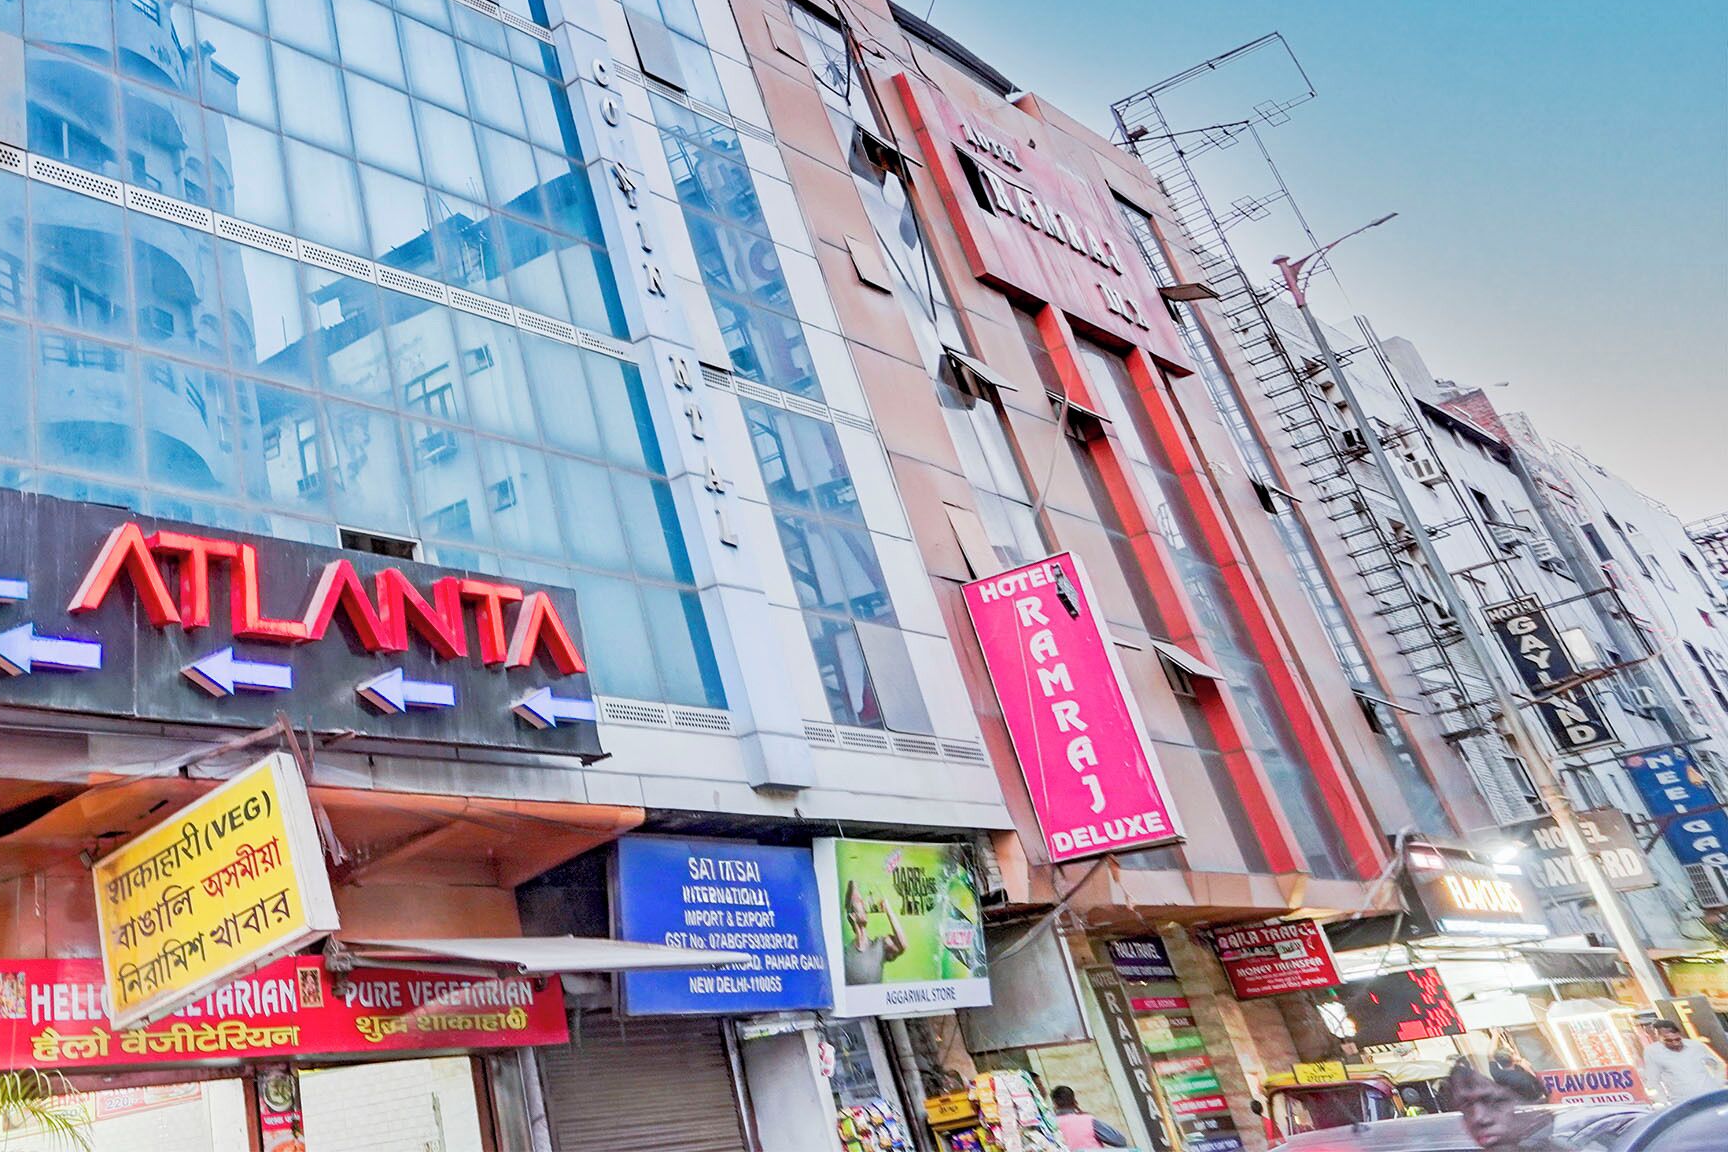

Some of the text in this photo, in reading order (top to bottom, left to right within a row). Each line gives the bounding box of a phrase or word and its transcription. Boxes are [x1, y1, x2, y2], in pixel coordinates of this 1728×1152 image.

[980, 166, 1122, 276] RAMRAJ
[68, 521, 586, 676] ATLANTA
[979, 562, 1062, 603] HOTEL
[1016, 596, 1106, 815] RAMRAJ
[1051, 811, 1166, 853] DELUXE
[1532, 820, 1609, 851] HOEL
[1530, 847, 1645, 888] GAYLRD
[684, 910, 775, 928] IMPORT & EXPORT
[665, 932, 688, 949] GST
[765, 954, 800, 970] PAHAR
[172, 978, 299, 1020] ETARIAN
[345, 978, 535, 1009] PURE VEGETARIAN
[689, 976, 715, 994] NEW
[885, 986, 957, 1006] AGGARWAL STORE
[30, 1025, 110, 1061] हैलो
[1103, 990, 1170, 1147] RAMRAJ
[1543, 1070, 1634, 1095] FLAVOURS
